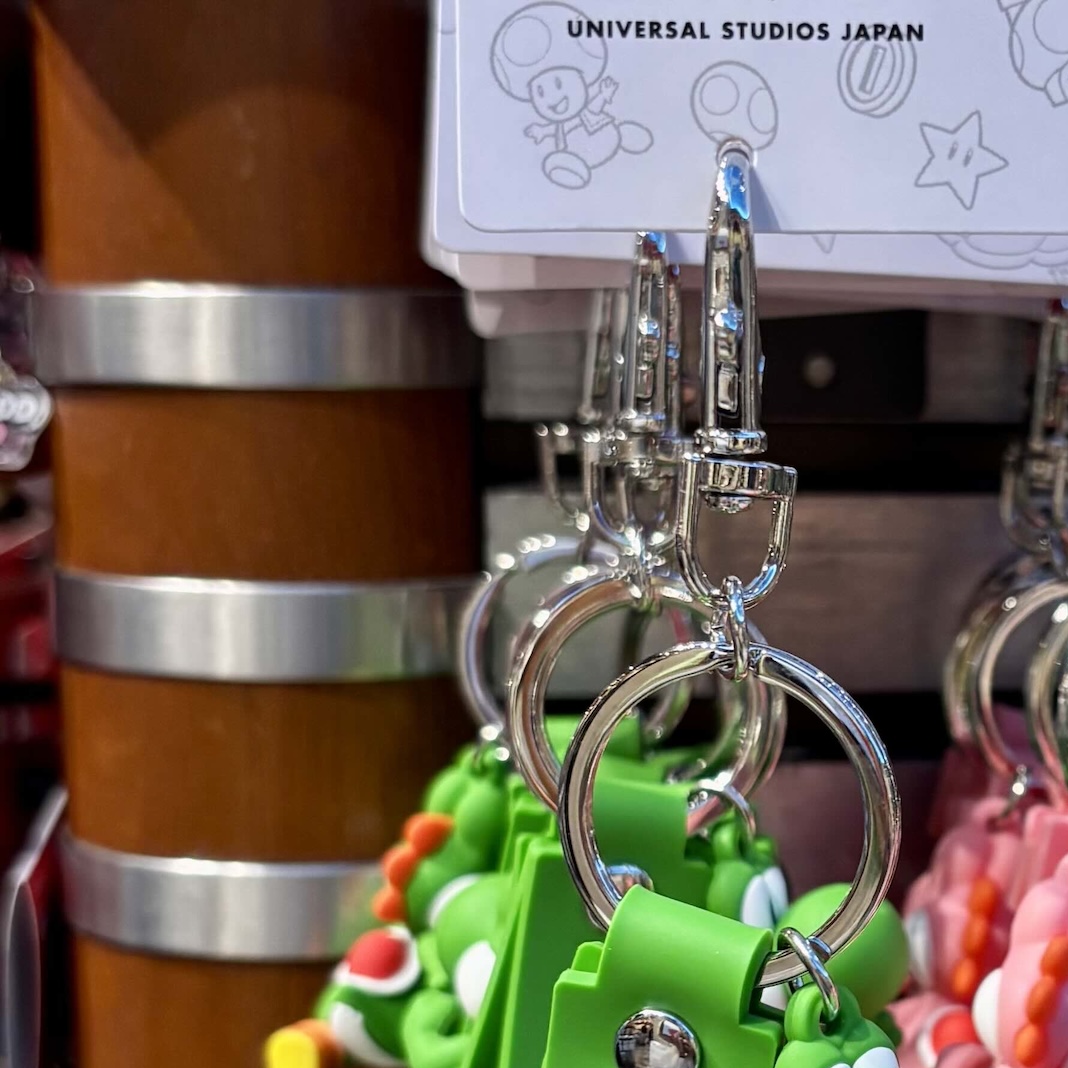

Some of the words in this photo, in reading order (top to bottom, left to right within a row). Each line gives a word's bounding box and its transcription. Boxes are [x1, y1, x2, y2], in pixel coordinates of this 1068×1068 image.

[567, 19, 710, 40] UNIVERSAL
[721, 21, 831, 42] STUDIOS
[840, 23, 925, 42] JAPAN
